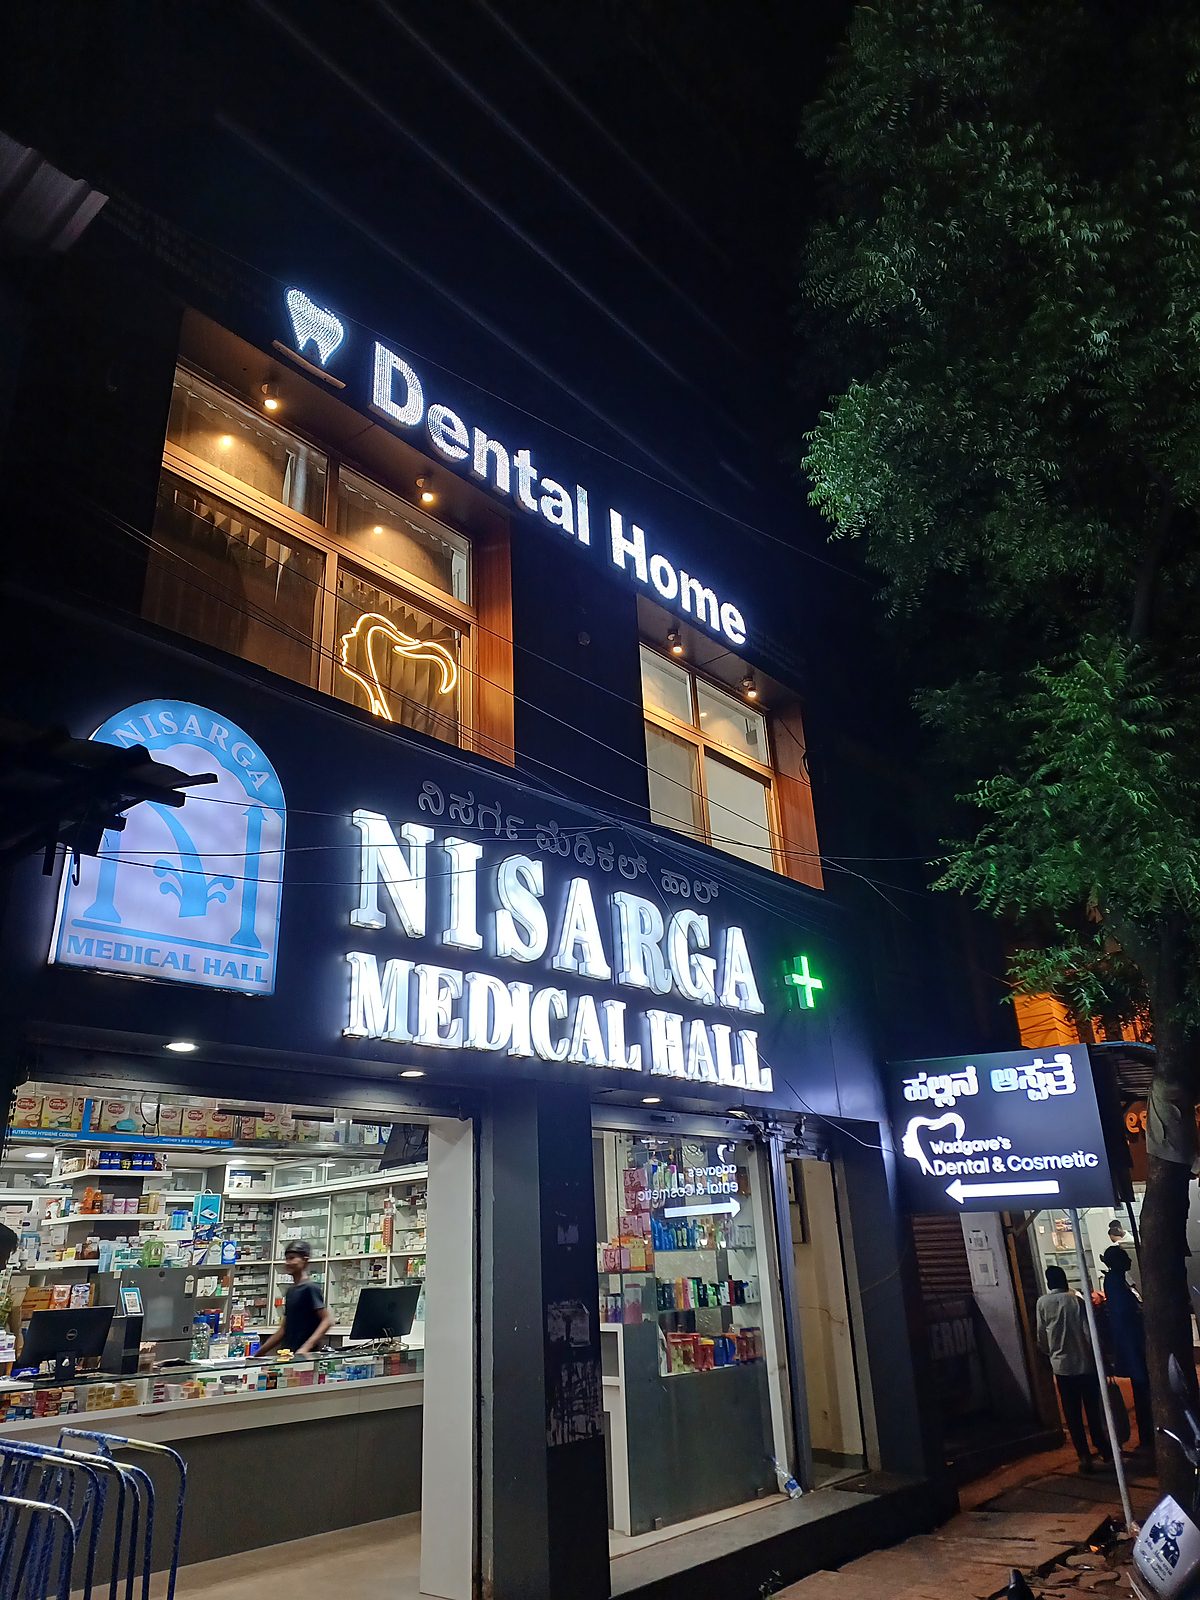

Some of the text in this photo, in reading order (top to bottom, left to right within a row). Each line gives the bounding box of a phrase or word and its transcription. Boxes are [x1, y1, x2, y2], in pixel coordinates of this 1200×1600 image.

[371, 340, 748, 646] Dental Home
[111, 711, 271, 792] NISARGA
[418, 780, 720, 904] ನಿಸರ್ಗ ಮೆಡಿಕಲ್ ಹಾಲ್
[66, 934, 269, 984] MEDICAL HALL
[349, 808, 766, 1015] NISARGA
[342, 950, 775, 1093] MEDICAL HALL
[929, 1136, 1011, 1156] Wadgave's
[932, 1149, 1099, 1177] Dental & Cosmetic
